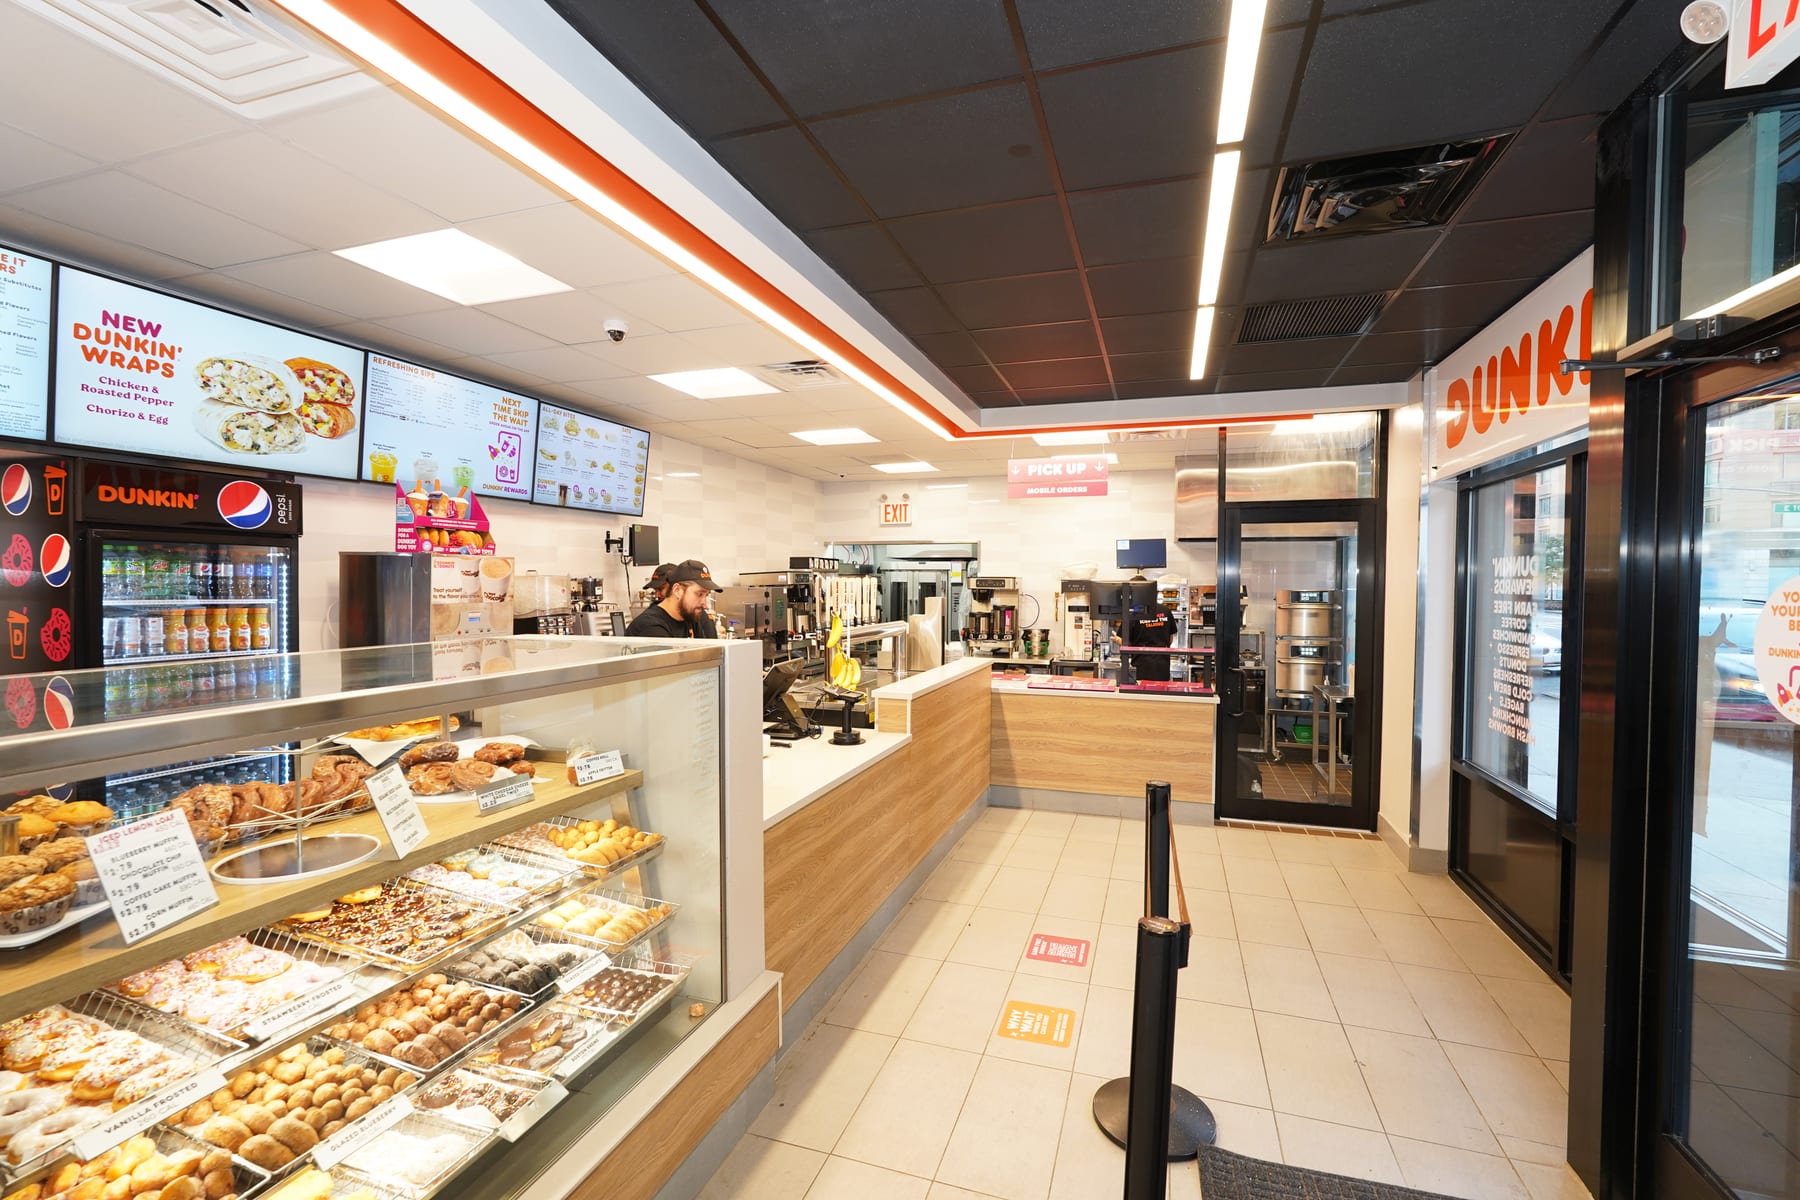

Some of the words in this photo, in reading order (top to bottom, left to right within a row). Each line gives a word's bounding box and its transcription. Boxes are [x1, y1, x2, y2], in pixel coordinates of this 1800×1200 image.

[13, 256, 26, 267] IT
[101, 309, 162, 338] NEW
[73, 322, 183, 361] DUNKIN'
[80, 344, 176, 379] WRAPS
[372, 356, 419, 375] REFRESHING
[420, 369, 436, 379] SIPS
[80, 383, 131, 400] Roasted
[133, 392, 175, 408] Pepper
[98, 375, 151, 393] Chicken
[151, 384, 160, 394] &
[492, 403, 512, 415] TIME
[513, 408, 529, 418] SKIP
[501, 396, 522, 408] NEXT
[86, 403, 136, 419] Chorizo
[137, 411, 146, 421] &
[148, 413, 169, 426] Egg
[492, 412, 508, 423] THE
[509, 416, 528, 427] WAIT
[1027, 463, 1063, 477] PICK
[1065, 462, 1087, 475] UP
[98, 485, 199, 510] DUNKIN'
[482, 483, 505, 492] DUNKIN'
[503, 486, 528, 495] REWARDS
[1026, 487, 1056, 495] MOBILE
[1056, 486, 1088, 494] ORDERS
[276, 493, 288, 525] pepsi
[884, 503, 909, 523] EXIT
[99, 832, 121, 843] ICED
[122, 822, 155, 837] LEMON
[155, 813, 175, 826] LOAF
[110, 845, 152, 864] BLUEBERRY
[153, 835, 179, 848] MUFFIN
[102, 861, 133, 877] $2.79
[120, 858, 165, 881] CHOCOLATE
[165, 853, 182, 863] CHIP
[142, 865, 169, 879] MUFFIN
[111, 882, 140, 897] $2.79
[123, 890, 152, 907] COFFEE
[153, 882, 172, 895] CAKE
[172, 872, 198, 886] MUFFIN
[120, 903, 148, 918] $2.79
[146, 909, 168, 921] CORN
[168, 896, 194, 911] MUFFIN
[128, 921, 156, 939] $2.79
[262, 999, 311, 1026] STRAWBERRY
[311, 984, 343, 1002] FROSTED
[1007, 1009, 1024, 1030] WHY
[1019, 1010, 1036, 1033] WAIT
[104, 1106, 153, 1134] VANILLA
[152, 1082, 199, 1109] FROSTED
[330, 1130, 360, 1152] GLAZED
[359, 1106, 397, 1132] BLUEBERRY
